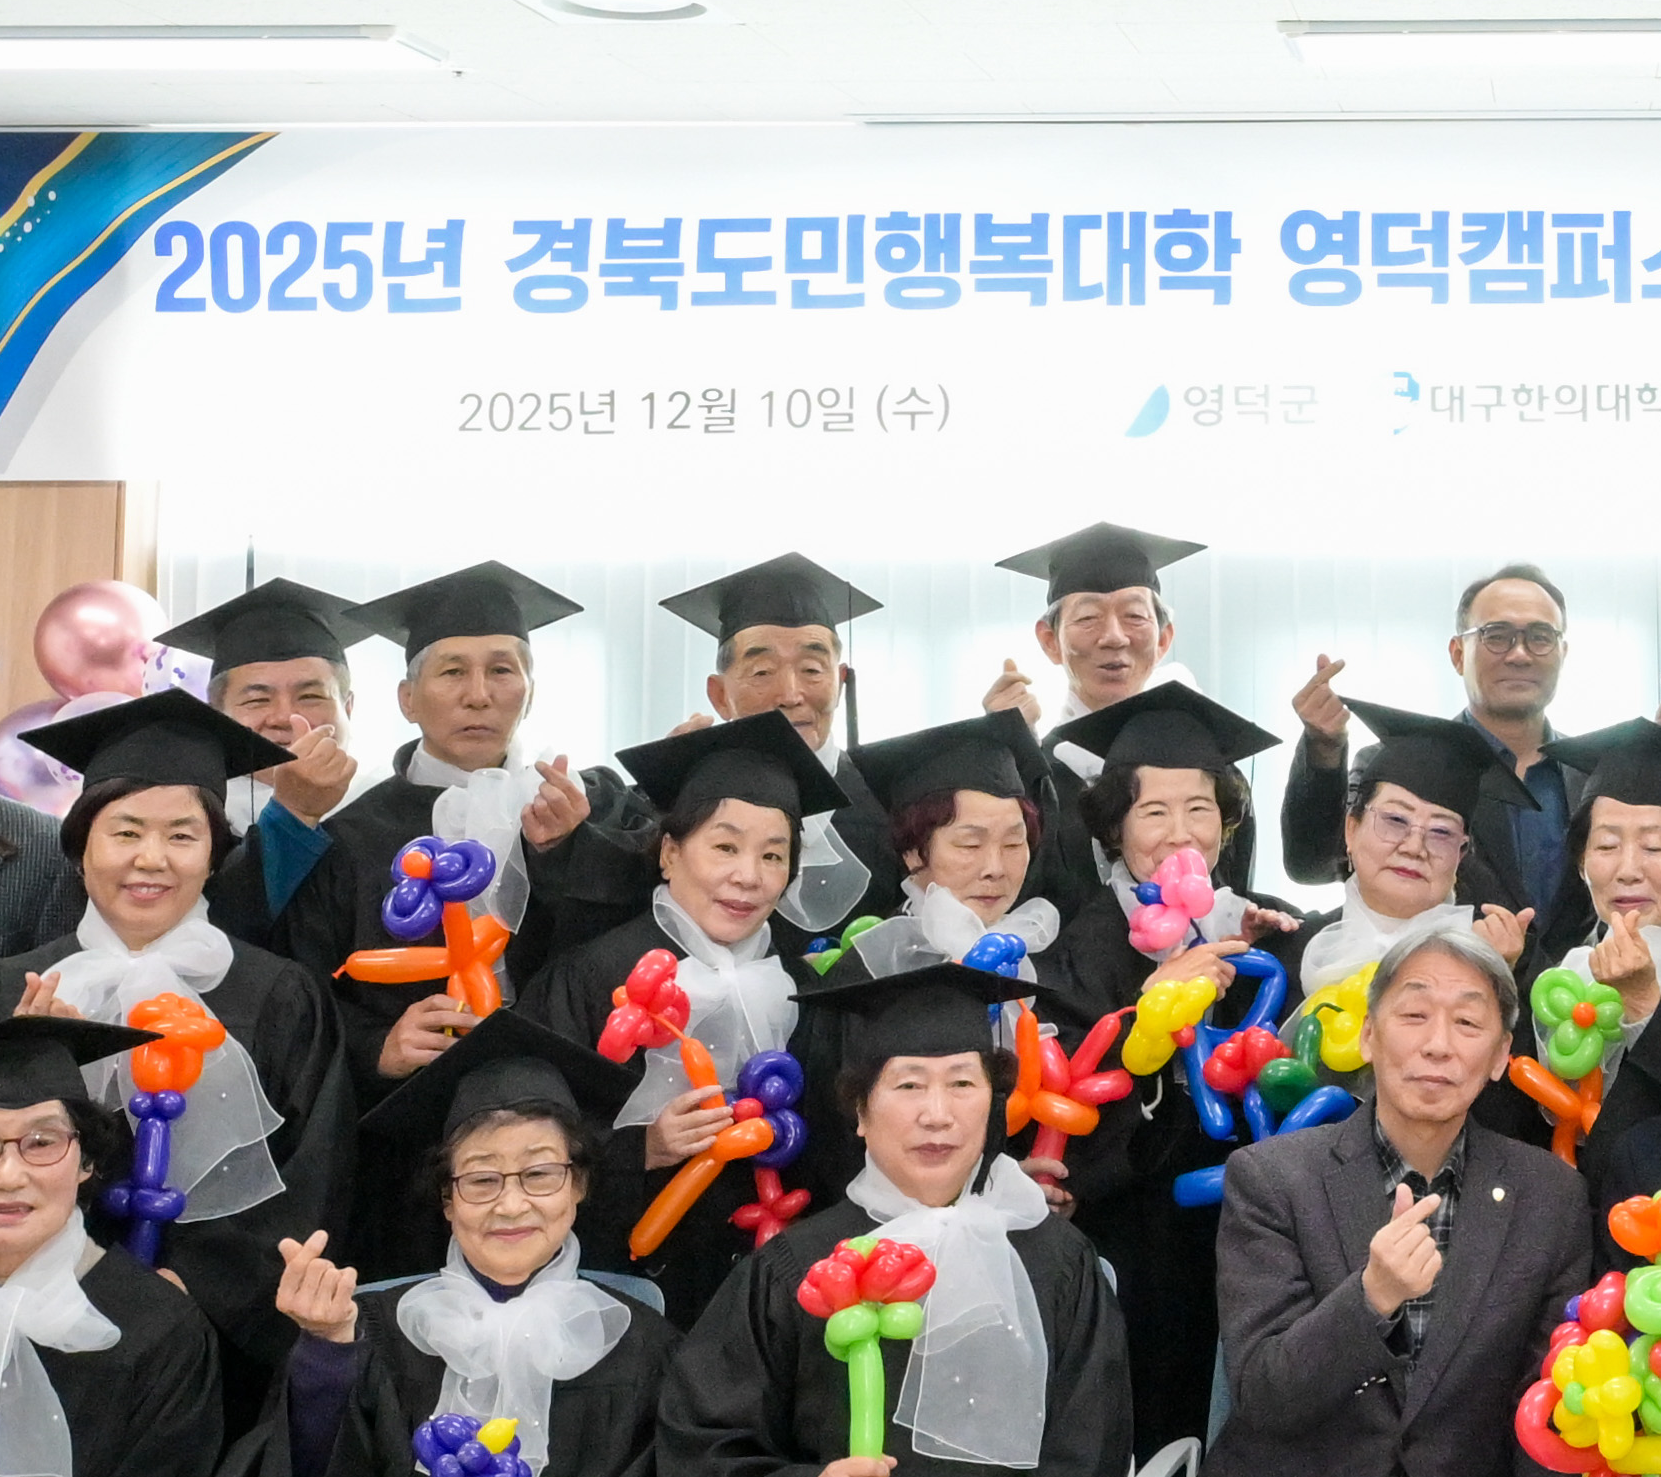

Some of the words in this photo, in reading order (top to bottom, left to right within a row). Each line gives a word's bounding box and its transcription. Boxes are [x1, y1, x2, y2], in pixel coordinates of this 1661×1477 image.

[154, 217, 464, 315] 2025년
[506, 209, 1242, 313] 경북도민행복대학
[458, 389, 617, 435] 2025년
[640, 387, 738, 434] 12월
[760, 386, 856, 433] 10일
[876, 383, 951, 433] (수)
[1183, 384, 1320, 428] 영덕군
